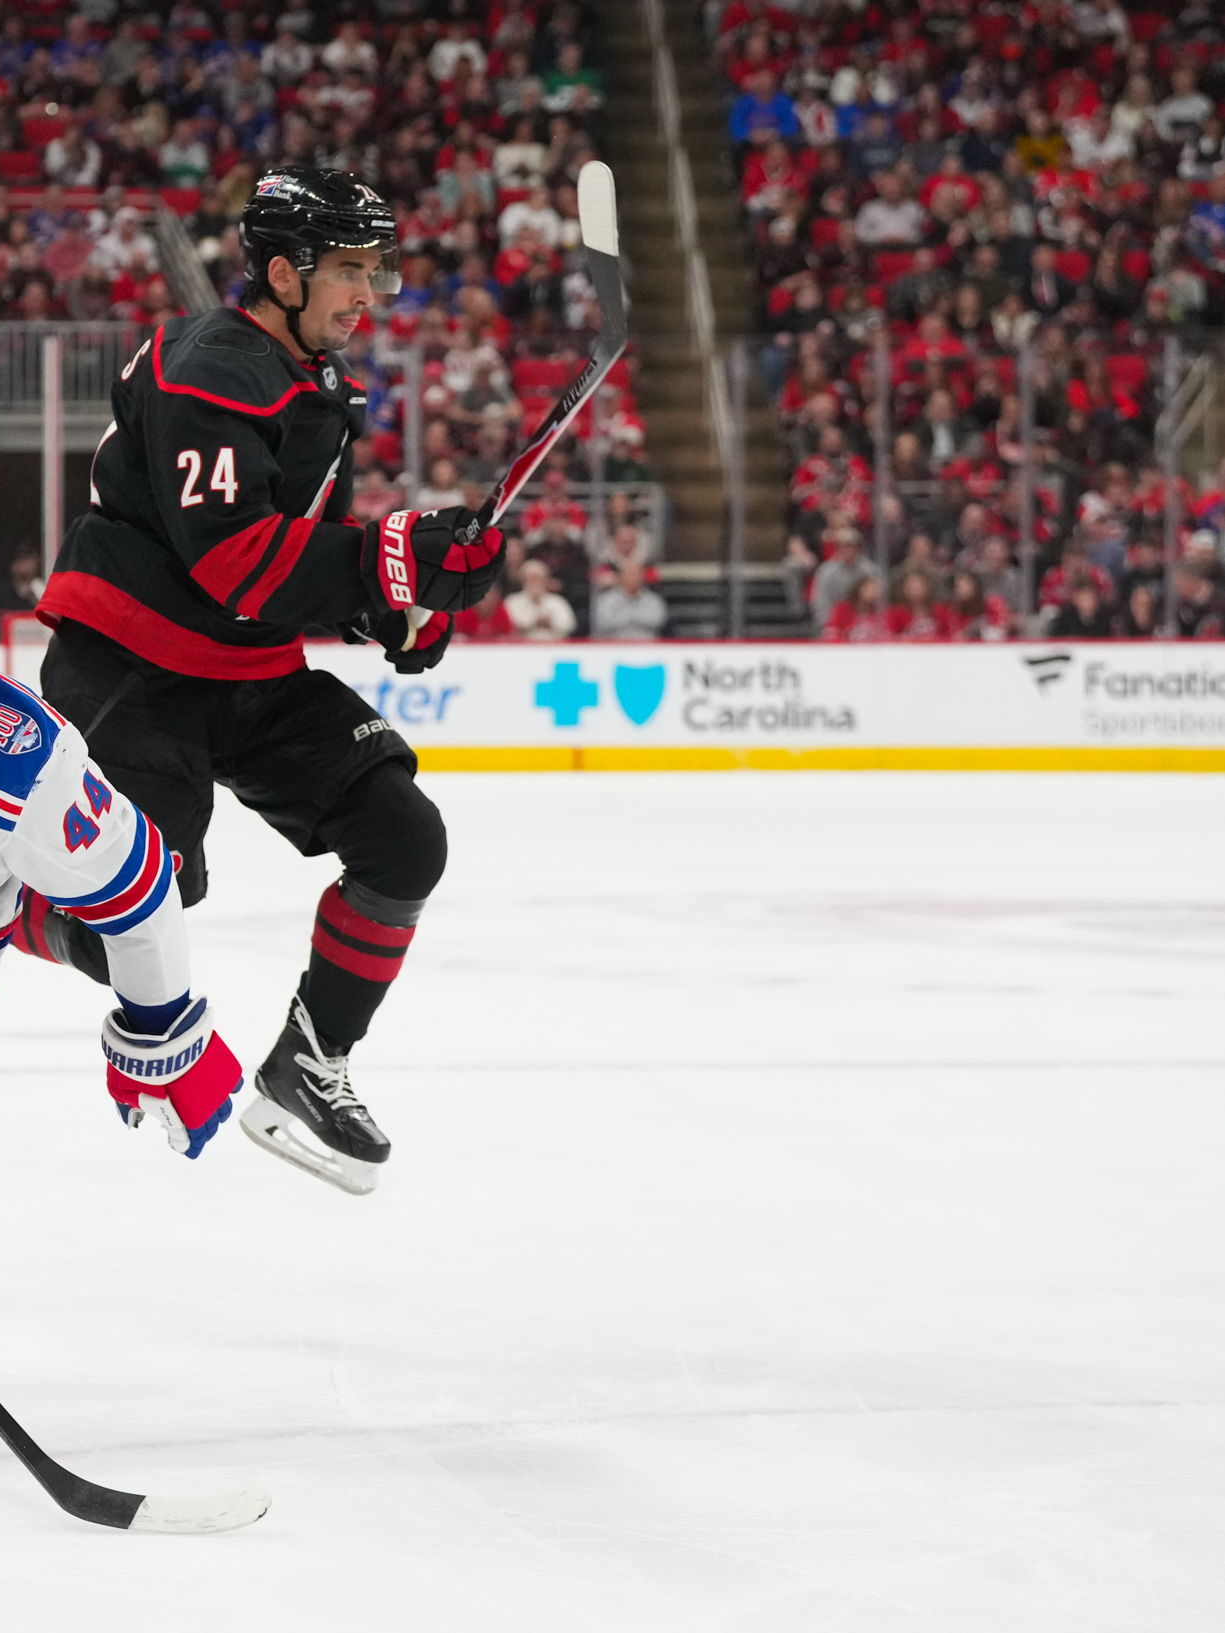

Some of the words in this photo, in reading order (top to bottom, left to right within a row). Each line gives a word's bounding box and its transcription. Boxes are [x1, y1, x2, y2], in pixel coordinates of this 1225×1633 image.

[177, 447, 238, 509] 24
[682, 658, 802, 692] North
[354, 678, 460, 724] ter
[682, 698, 859, 733] Carolina
[62, 767, 113, 855] 44
[102, 1035, 204, 1077] WARRIOR
